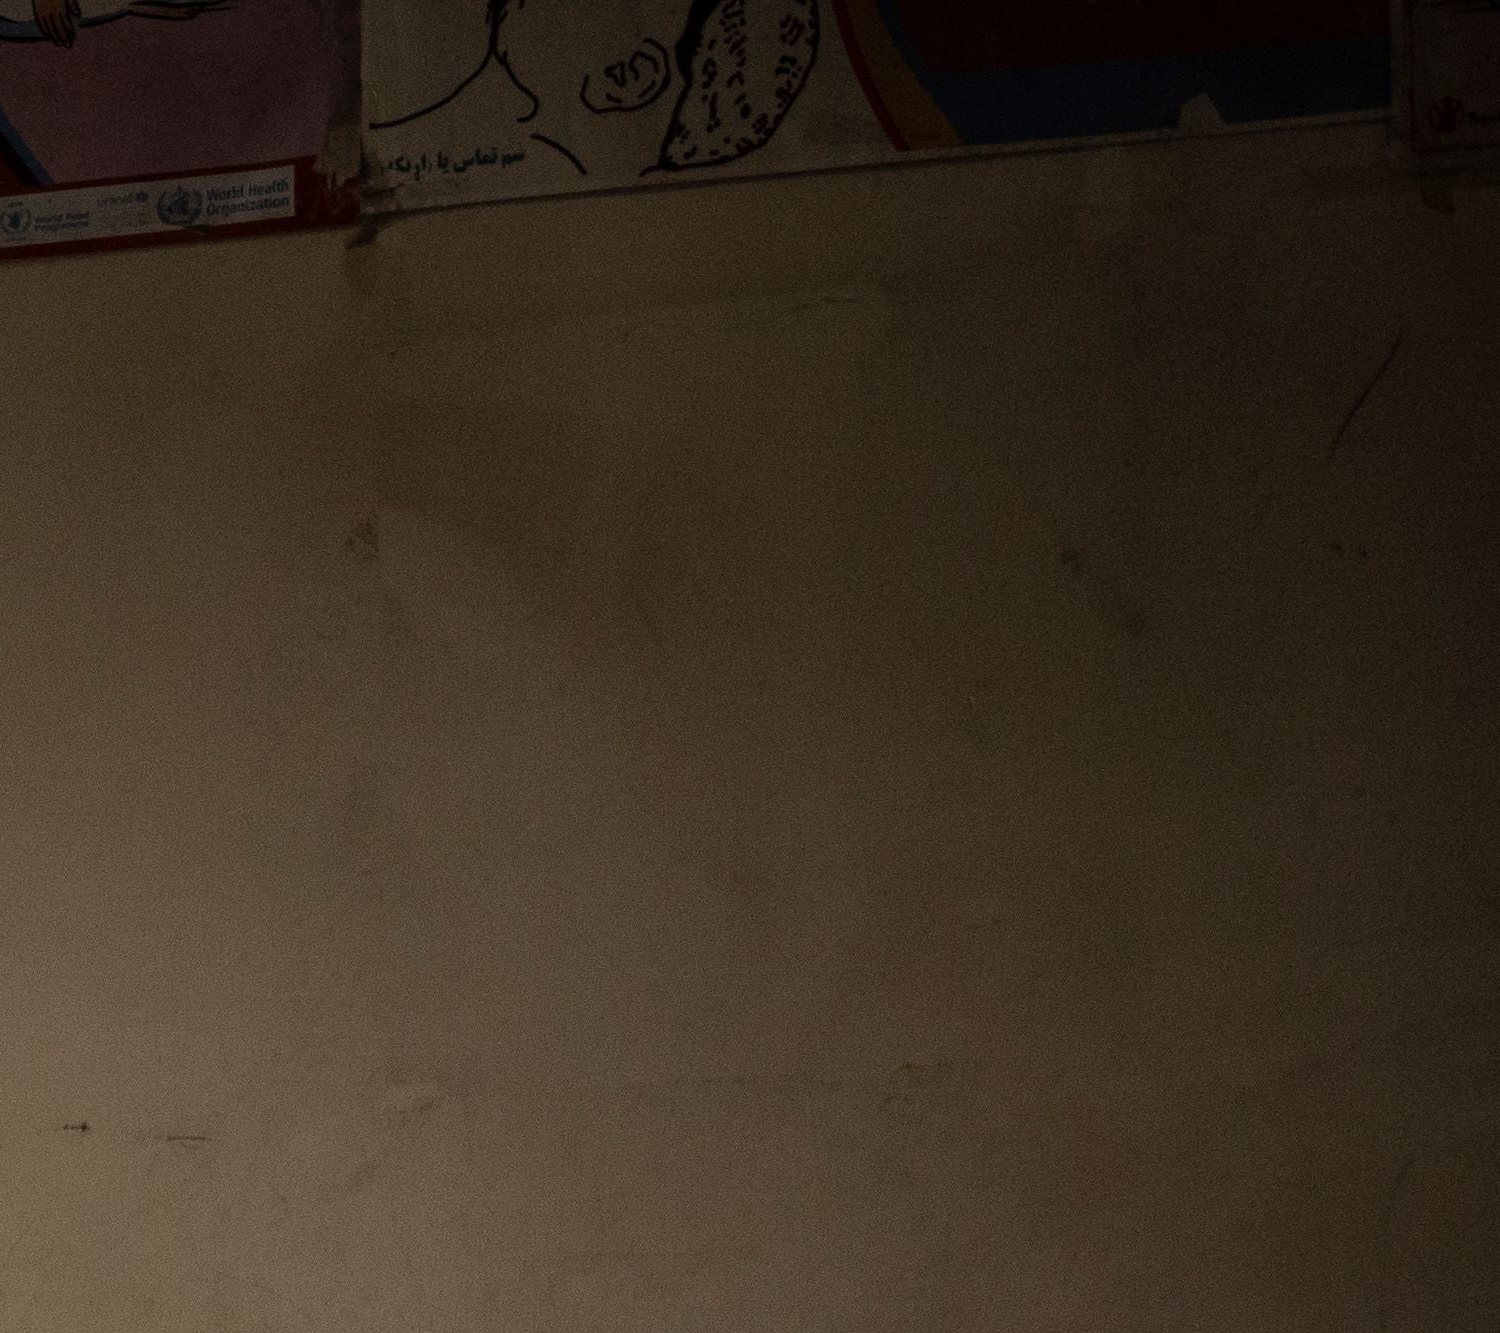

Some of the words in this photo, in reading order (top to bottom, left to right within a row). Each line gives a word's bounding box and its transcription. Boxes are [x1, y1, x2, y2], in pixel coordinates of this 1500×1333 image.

[205, 184, 244, 202] World
[248, 178, 290, 198] Health
[205, 196, 290, 217] Organization
